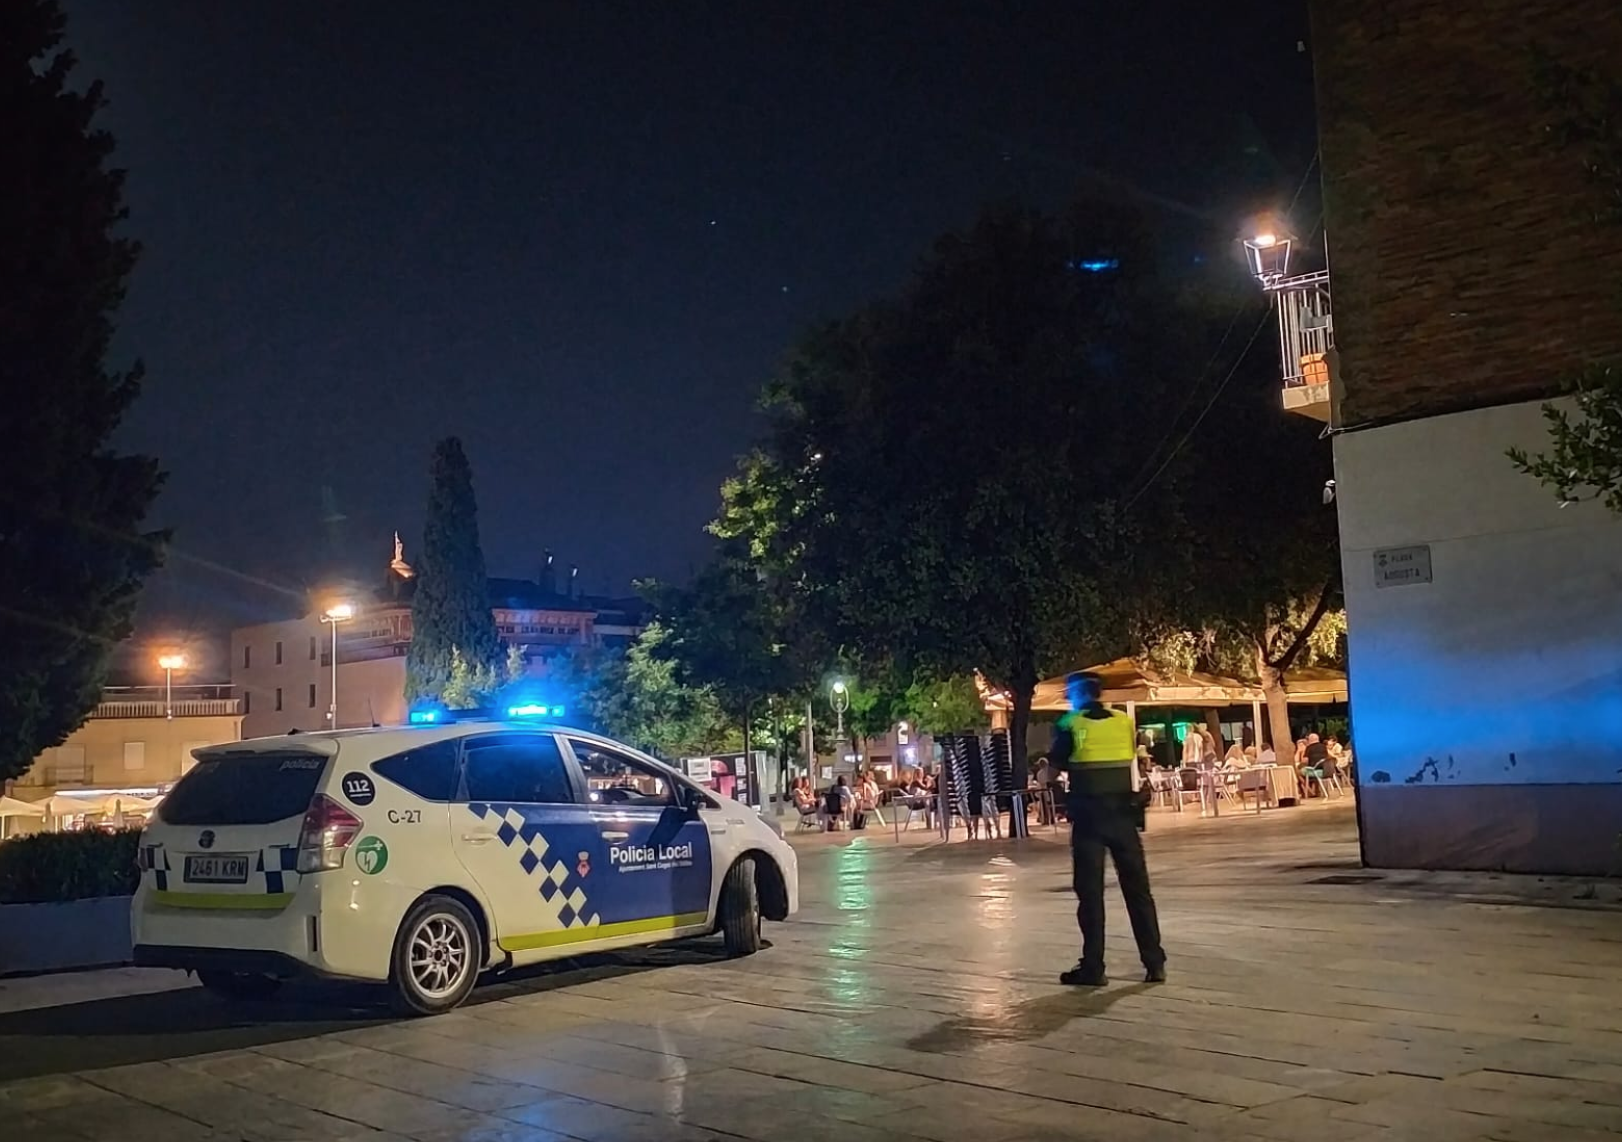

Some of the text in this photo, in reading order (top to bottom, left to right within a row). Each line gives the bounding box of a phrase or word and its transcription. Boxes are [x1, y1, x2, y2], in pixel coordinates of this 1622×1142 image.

[346, 780, 371, 793] 112
[387, 809, 422, 824] C-27
[610, 841, 693, 865] Policia Local
[192, 859, 218, 877] 2461
